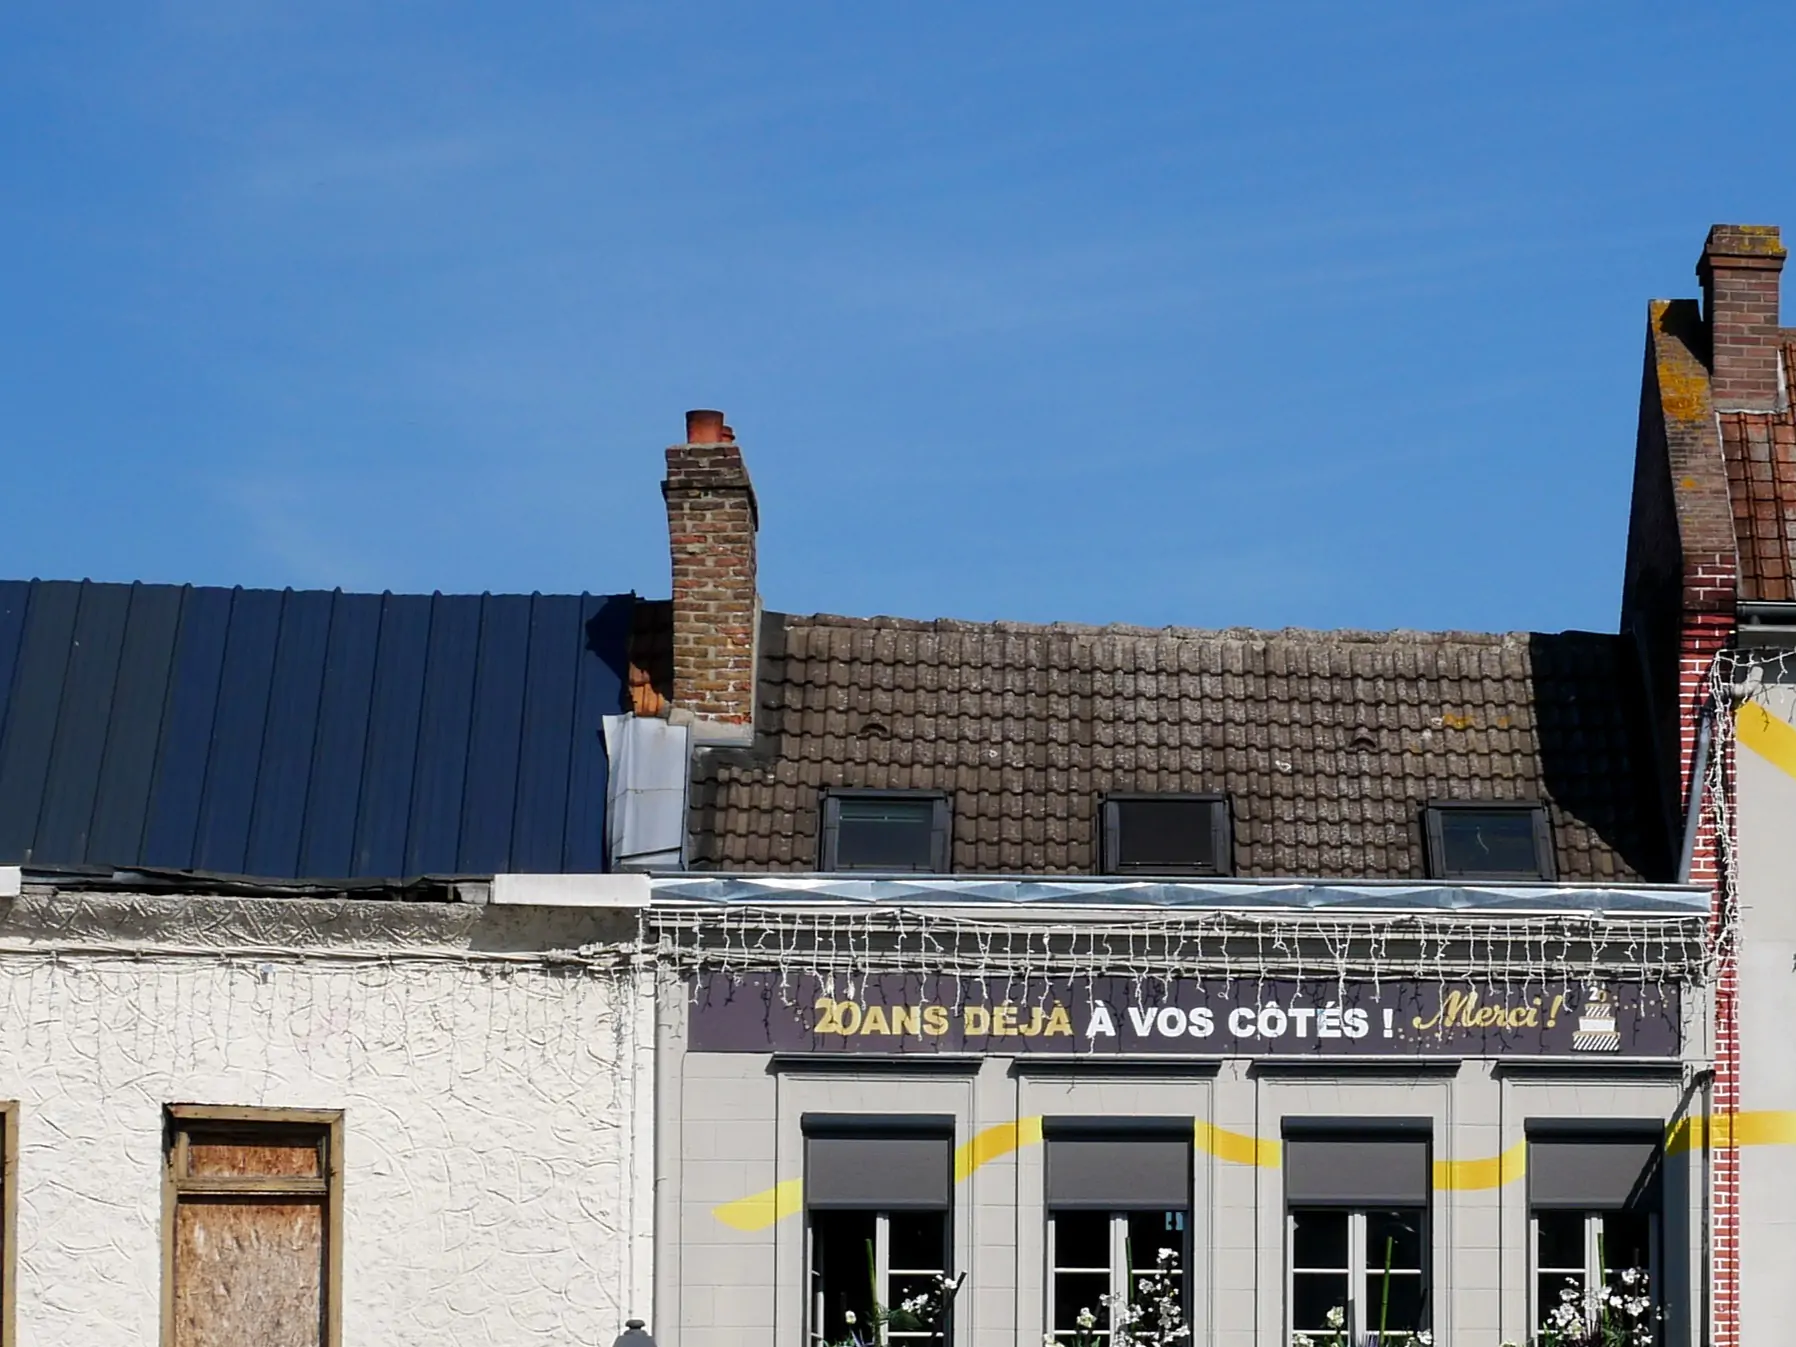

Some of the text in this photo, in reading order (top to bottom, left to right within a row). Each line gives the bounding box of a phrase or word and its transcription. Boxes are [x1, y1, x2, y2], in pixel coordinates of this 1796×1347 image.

[1086, 1000, 1116, 1037] À
[1128, 1006, 1215, 1037] VOS
[1228, 1001, 1369, 1038] CÔTÉS
[1412, 990, 1539, 1030] Merci
